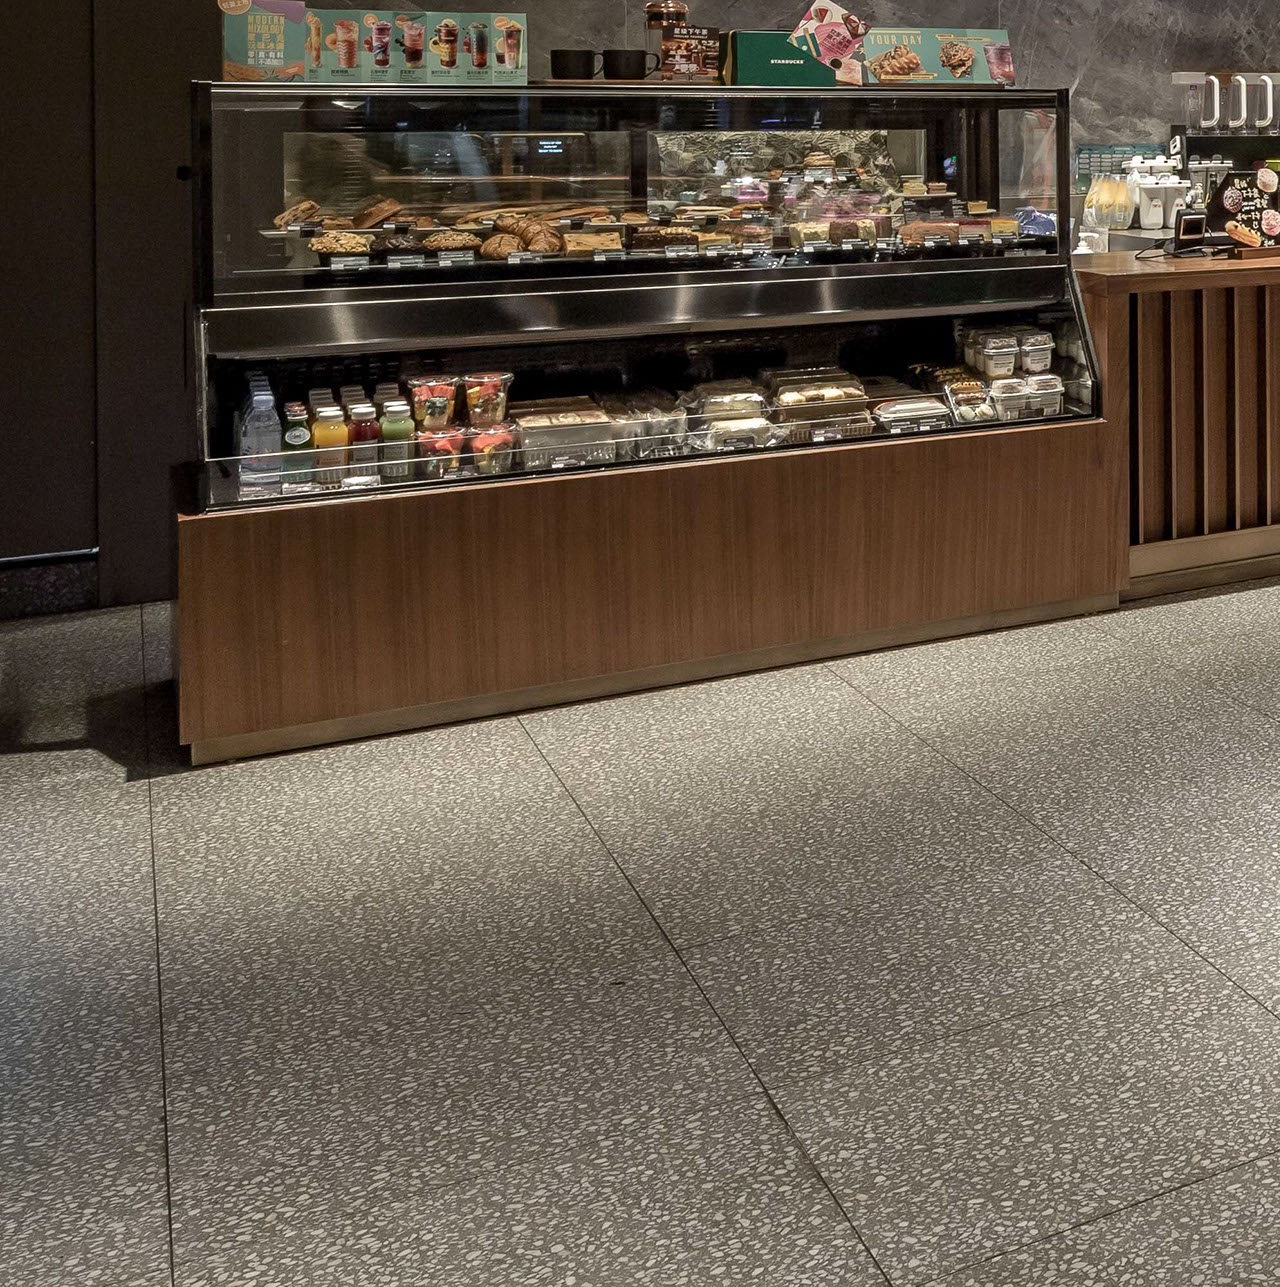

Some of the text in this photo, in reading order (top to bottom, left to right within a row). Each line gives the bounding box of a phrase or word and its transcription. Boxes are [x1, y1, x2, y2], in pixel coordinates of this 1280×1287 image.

[248, 14, 285, 26] MODERN
[248, 24, 285, 34] MIXOLOGY
[870, 34, 922, 46] YOUR DAY
